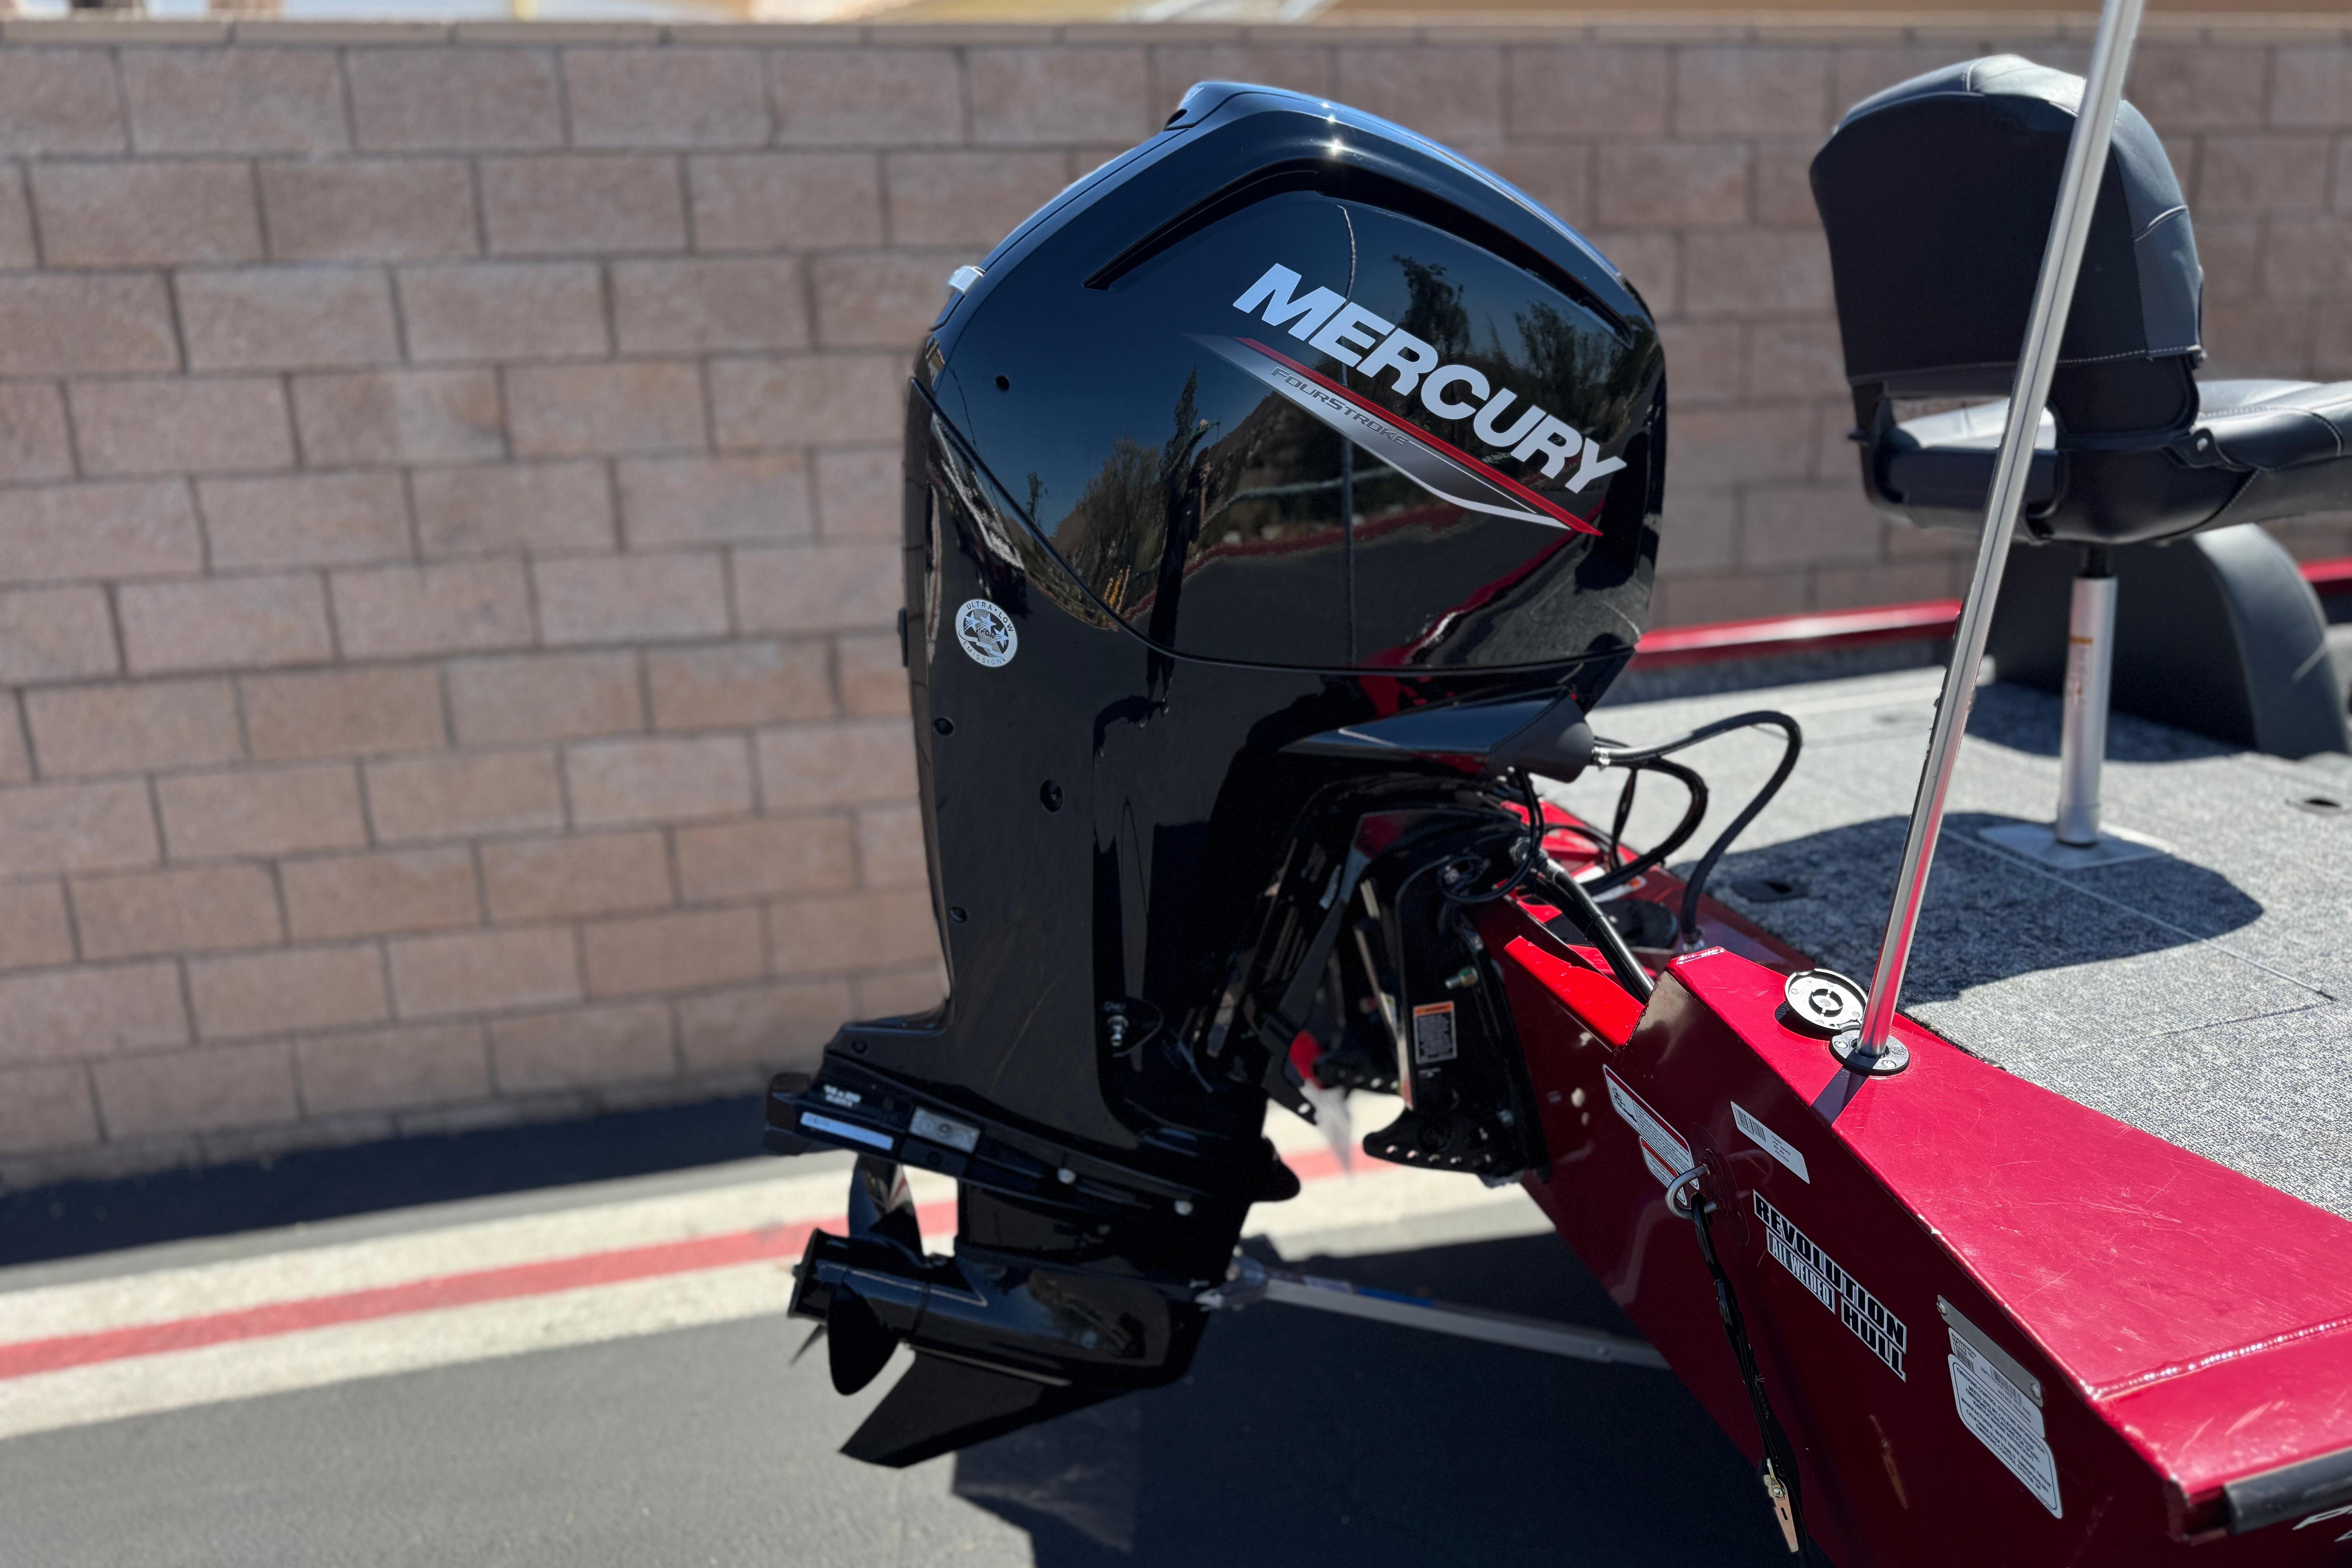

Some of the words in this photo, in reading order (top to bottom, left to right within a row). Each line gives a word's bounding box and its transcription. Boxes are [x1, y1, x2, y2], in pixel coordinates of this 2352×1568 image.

[1233, 263, 1627, 494] MERCURY
[1271, 367, 1409, 446] FOURSTROKE
[963, 641, 1001, 665] EMISSION
[966, 601, 992, 611] ULTRA
[999, 611, 1014, 632] LOW
[1755, 1193, 1905, 1347] REVOLUTION
[1771, 1236, 1789, 1267] ALL
[1790, 1252, 1830, 1306] WELDED
[1843, 1300, 1905, 1378] HULL
